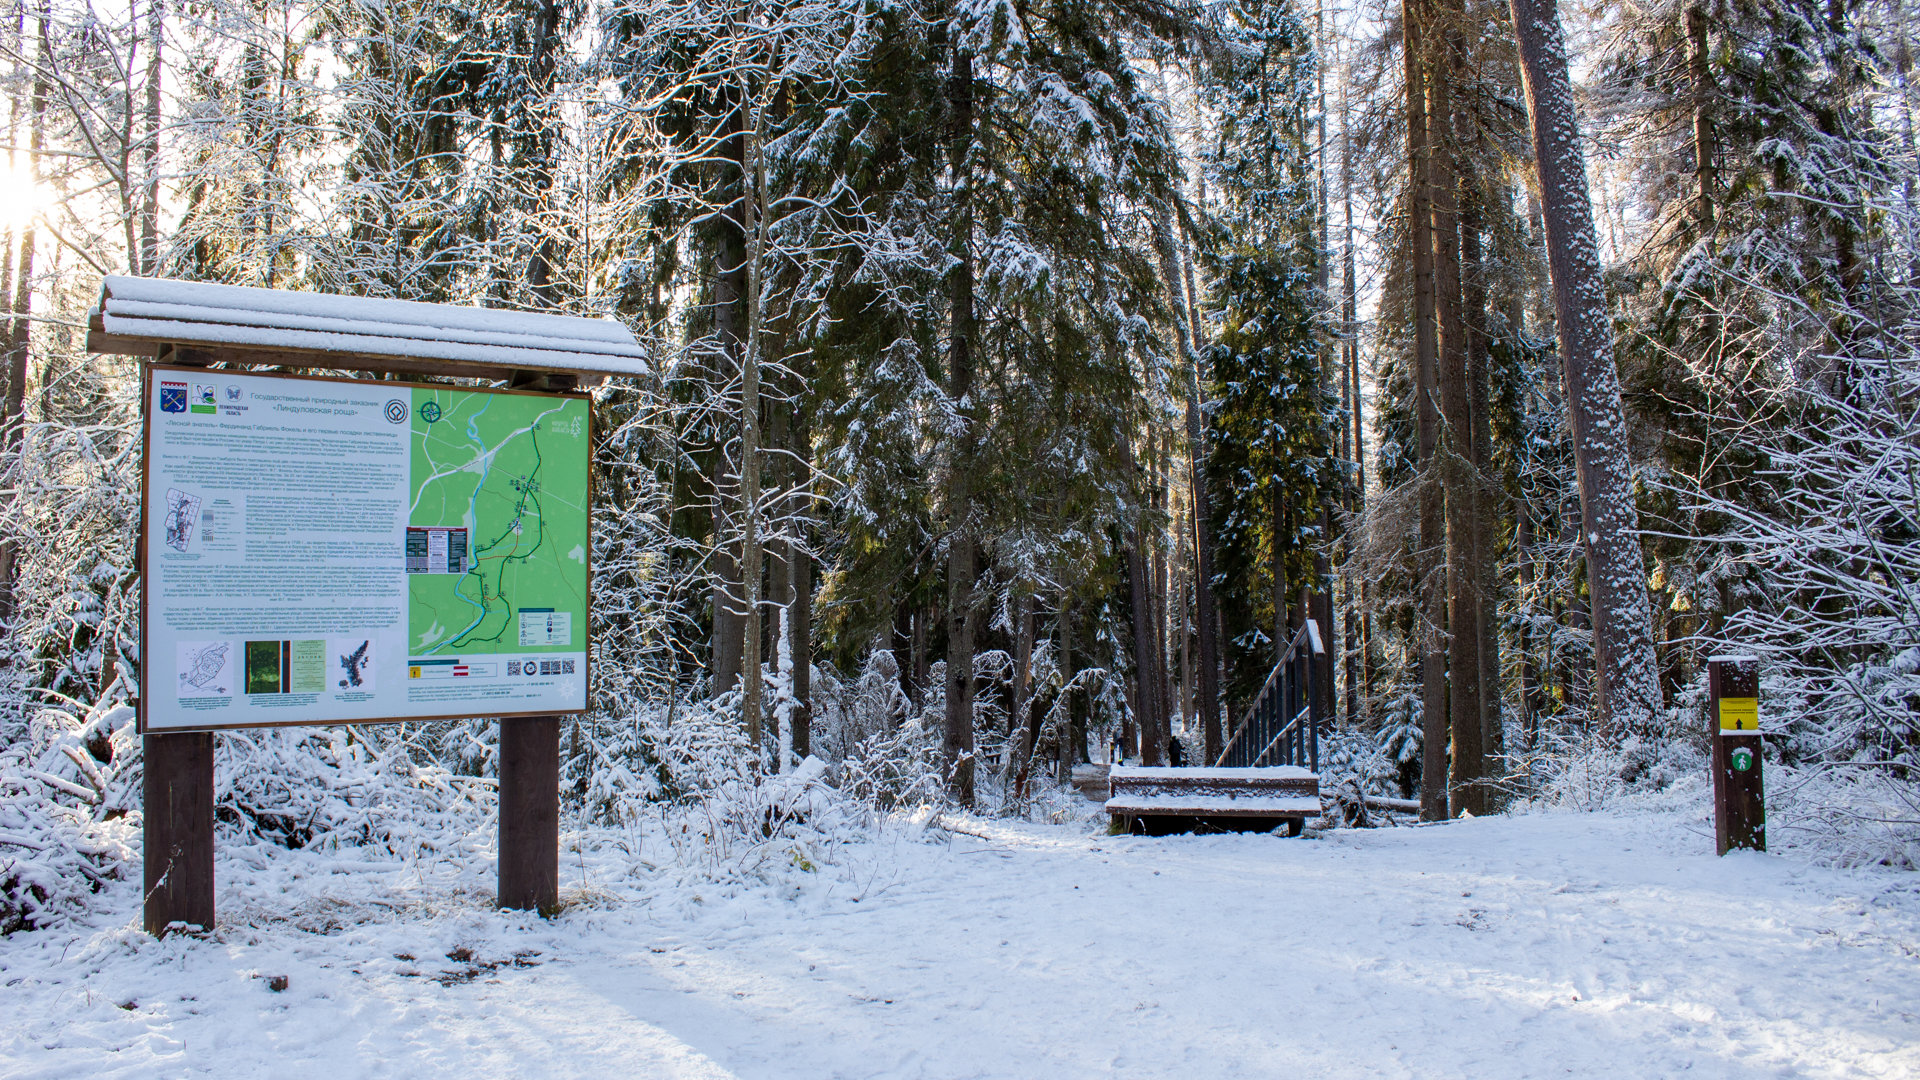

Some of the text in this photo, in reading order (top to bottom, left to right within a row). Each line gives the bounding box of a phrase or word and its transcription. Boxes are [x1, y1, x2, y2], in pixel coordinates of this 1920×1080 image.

[250, 392, 309, 402] Государственный
[311, 396, 349, 405] природный
[272, 404, 359, 416] «Линдуловская роща»
